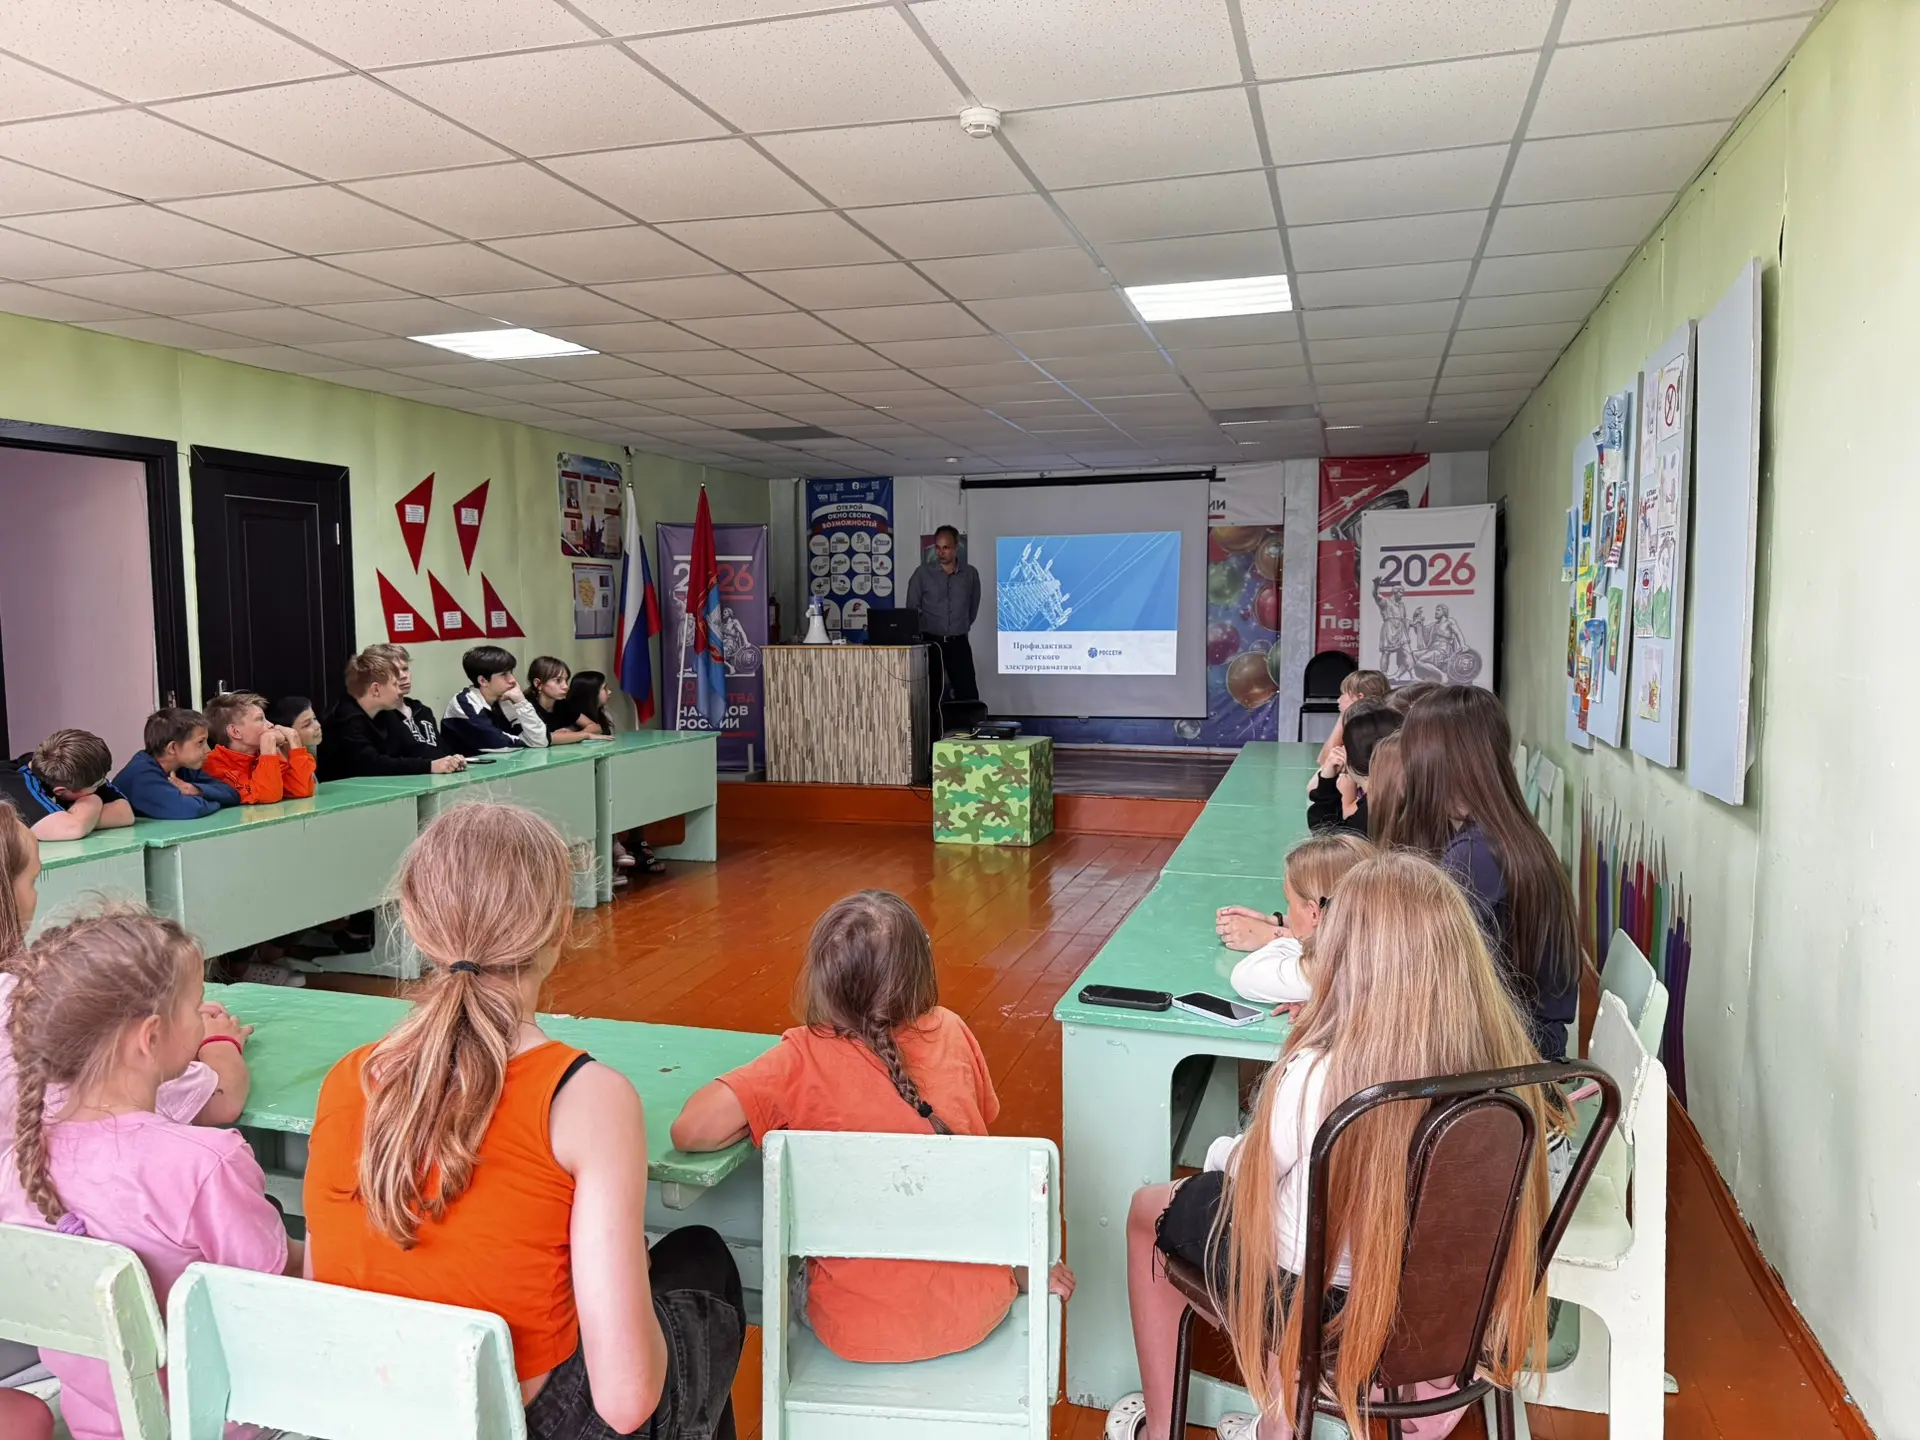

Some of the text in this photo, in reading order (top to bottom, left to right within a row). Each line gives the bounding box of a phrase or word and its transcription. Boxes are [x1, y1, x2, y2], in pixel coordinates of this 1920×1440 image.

[828, 512, 848, 520] ОКНО
[822, 519, 877, 529] ВОЗМОЖНОСТЕЙ
[1379, 552, 1476, 587] 2026
[673, 562, 754, 592] 226
[1013, 642, 1073, 651] Профилактика
[1004, 664, 1082, 672] электротравматизма
